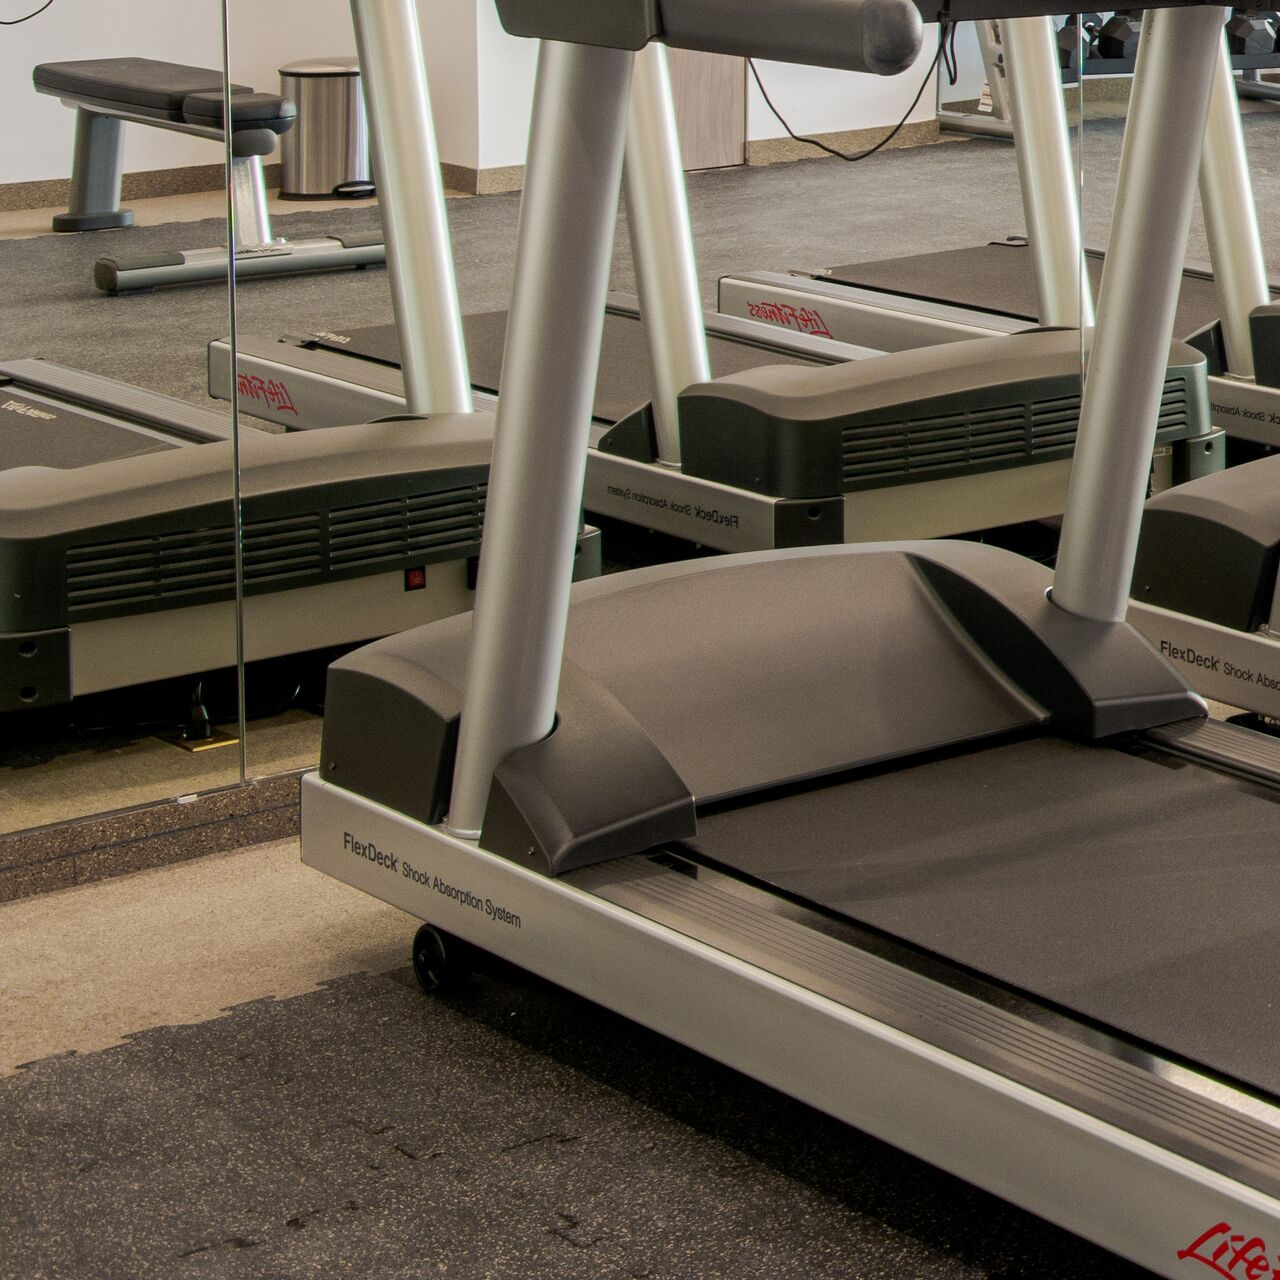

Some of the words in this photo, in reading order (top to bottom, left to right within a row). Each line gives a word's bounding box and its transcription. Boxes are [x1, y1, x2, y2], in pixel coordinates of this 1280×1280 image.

[1160, 640, 1218, 672] FlexDeck
[1223, 662, 1254, 684] Shock
[343, 831, 397, 873] FlexDeck
[402, 861, 430, 888] Shock
[433, 876, 483, 912] Absorption
[485, 898, 521, 929] System
